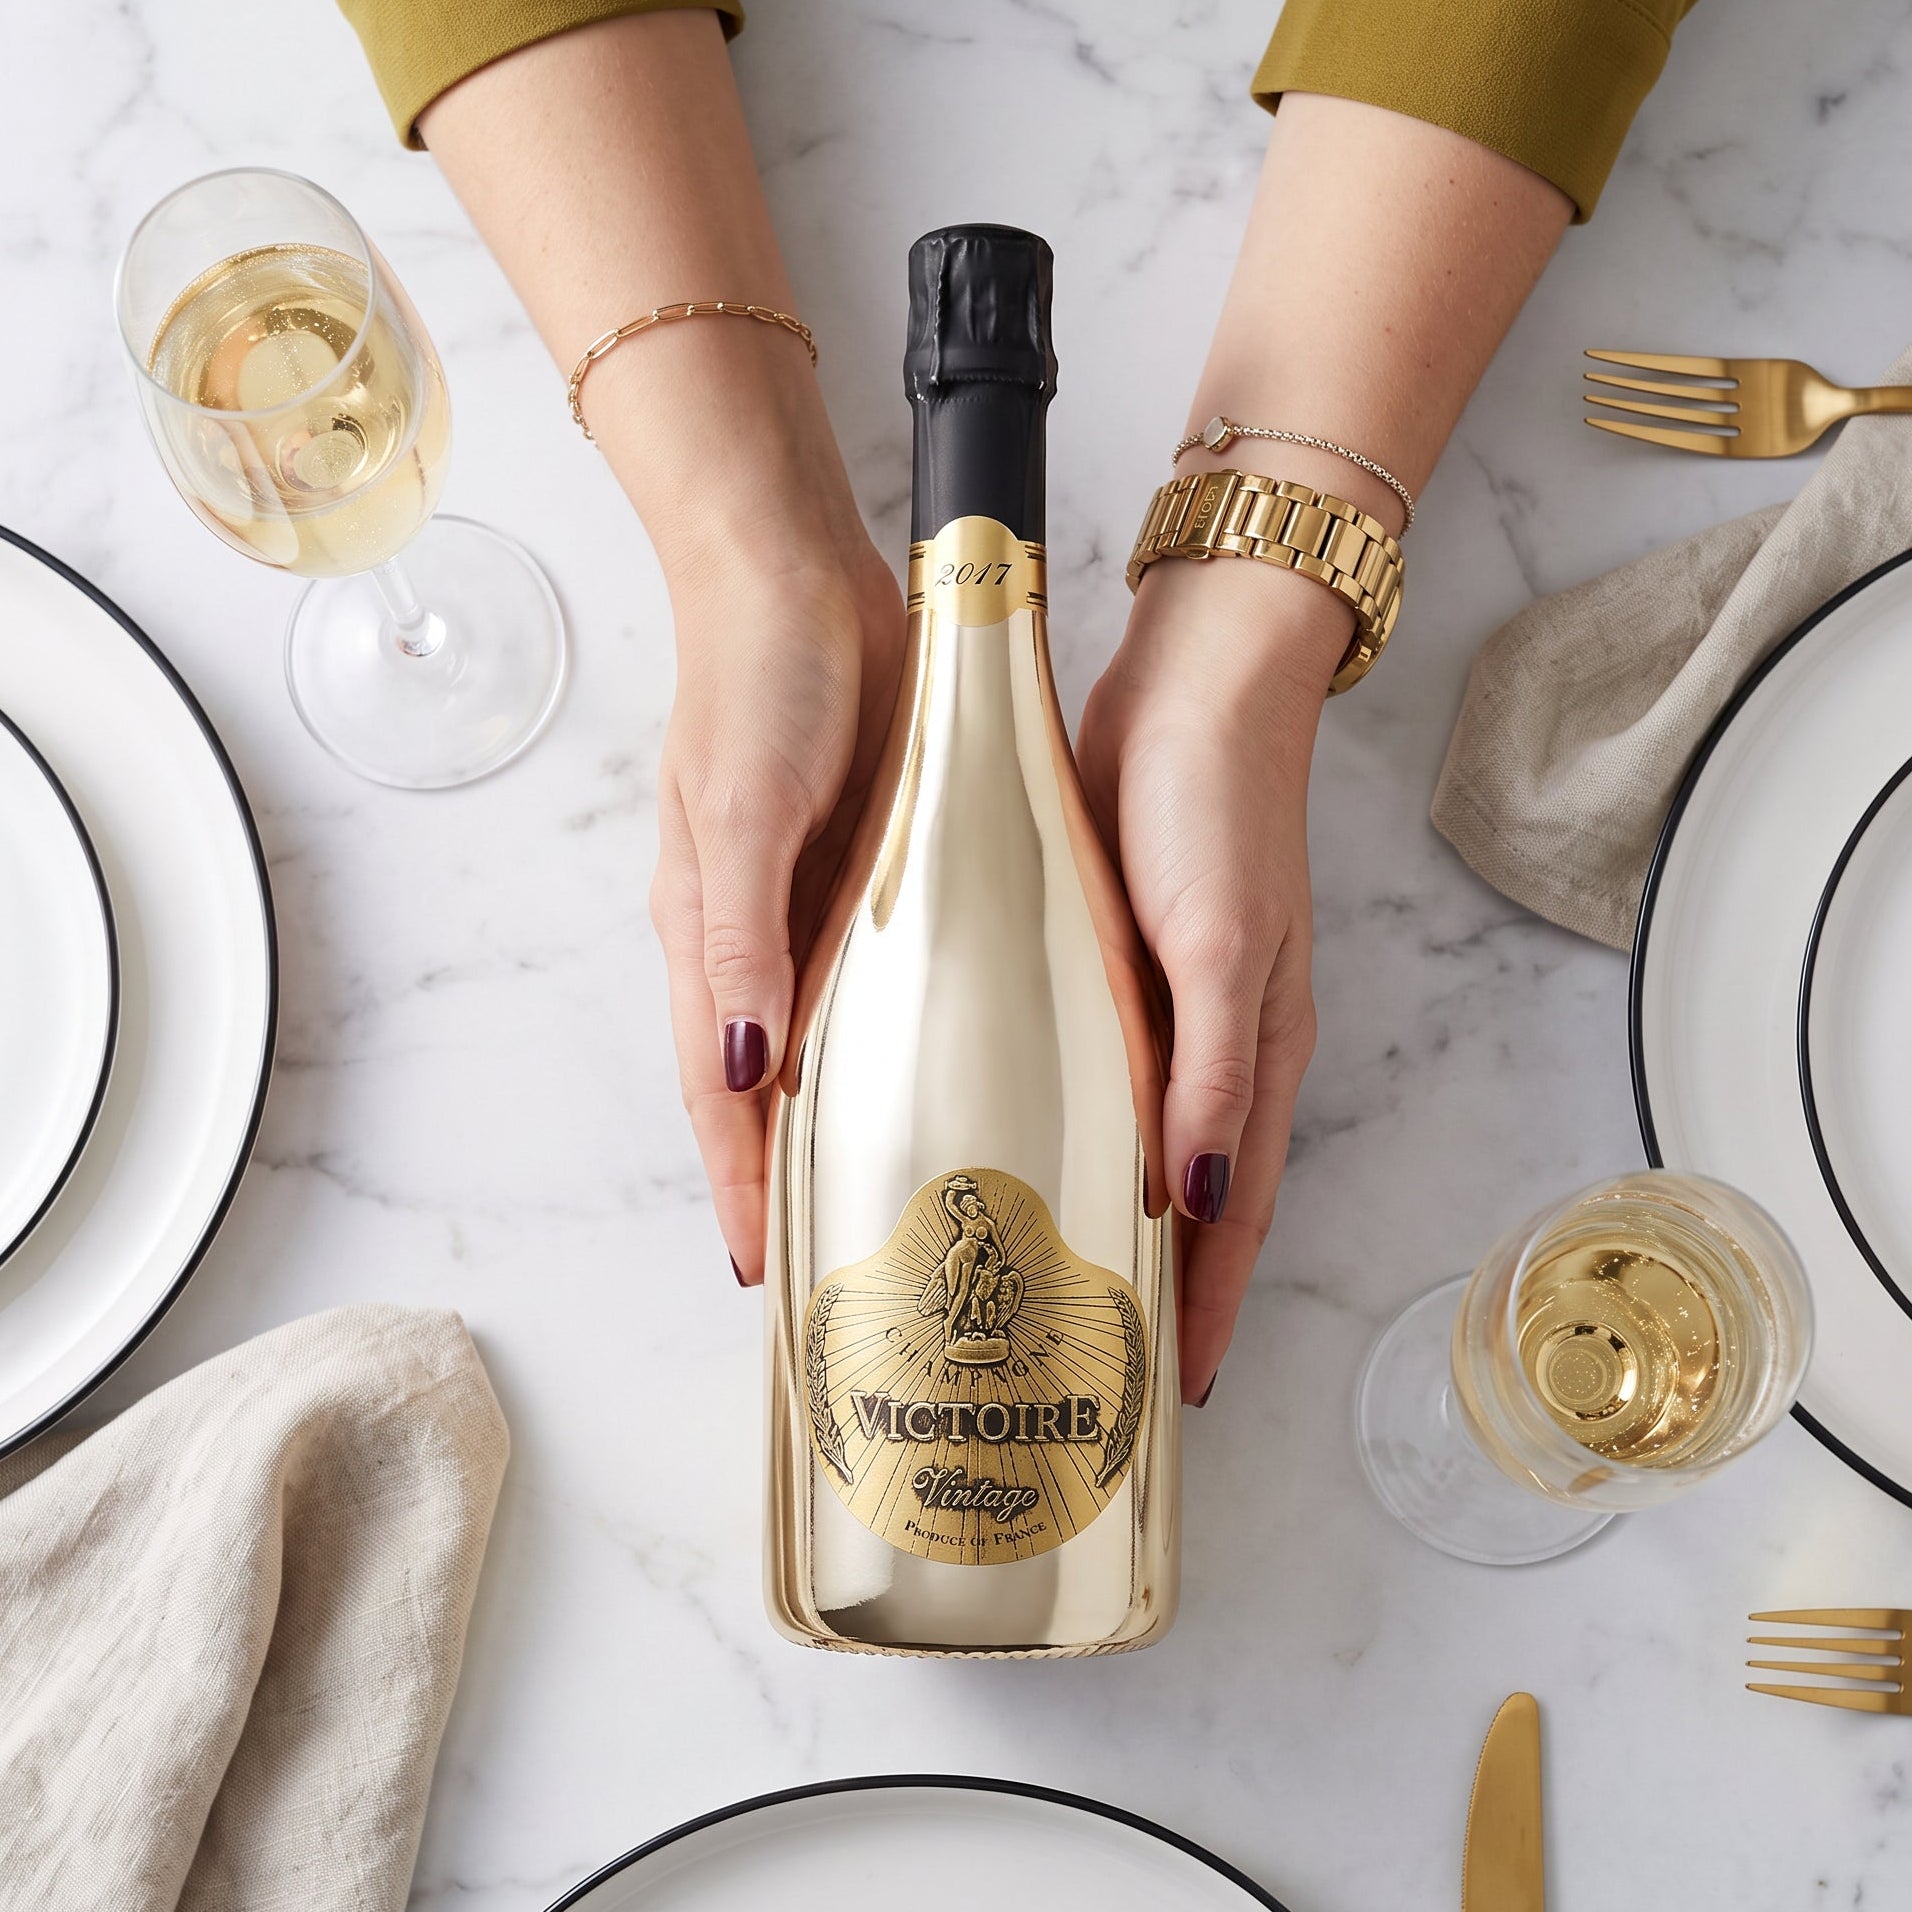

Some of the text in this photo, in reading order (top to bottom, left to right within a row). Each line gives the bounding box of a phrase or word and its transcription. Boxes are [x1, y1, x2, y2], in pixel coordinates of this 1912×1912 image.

[935, 562, 1013, 587] 2017
[850, 1389, 1101, 1442] VICTOIRE
[912, 1466, 1038, 1522] Vintage
[904, 1519, 966, 1547] PRODUCE
[993, 1521, 1047, 1546] FRANCE
